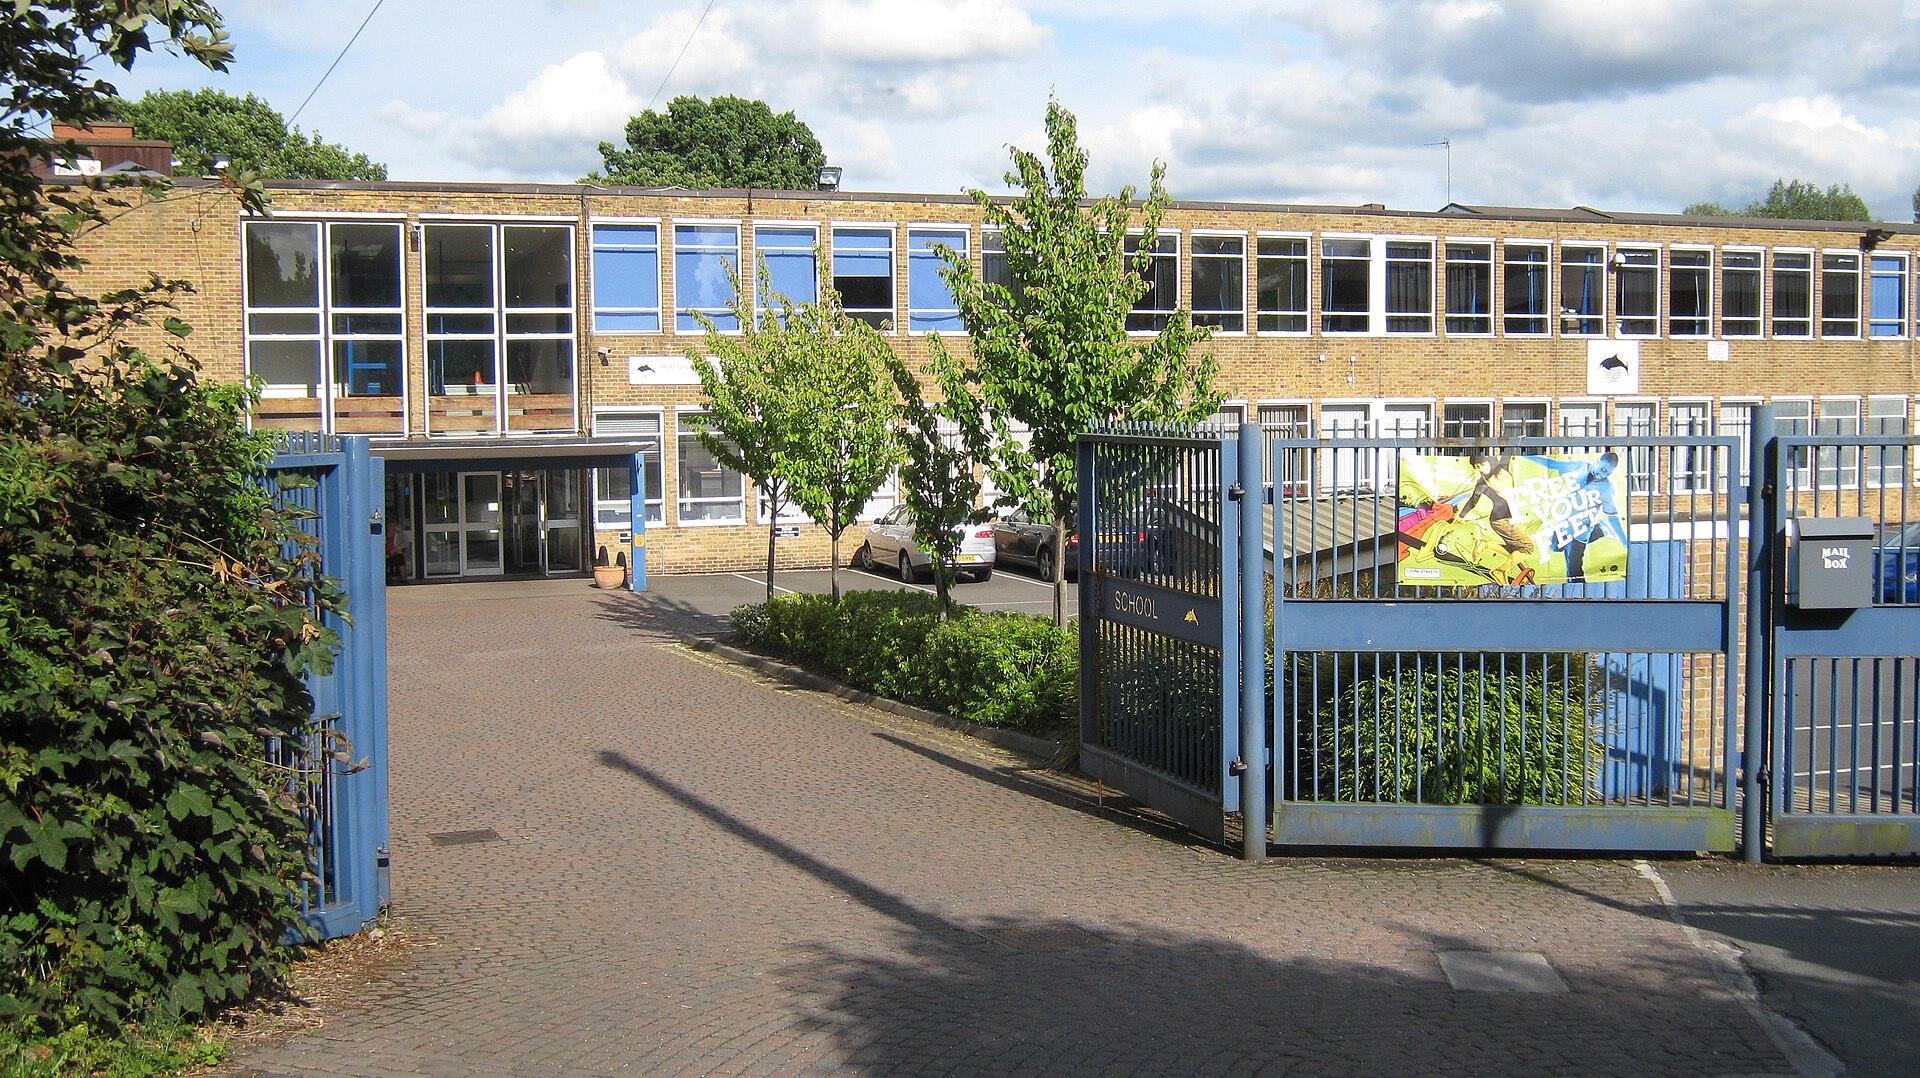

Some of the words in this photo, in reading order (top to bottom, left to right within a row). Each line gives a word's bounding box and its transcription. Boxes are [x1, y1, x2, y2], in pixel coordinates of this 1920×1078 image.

[1504, 471, 1580, 525] FREE
[1528, 488, 1603, 528] YOUR
[1531, 506, 1604, 564] FEET
[1821, 547, 1851, 559] MAIL
[1824, 557, 1848, 569] BOX
[1114, 590, 1159, 620] SCHOOL
